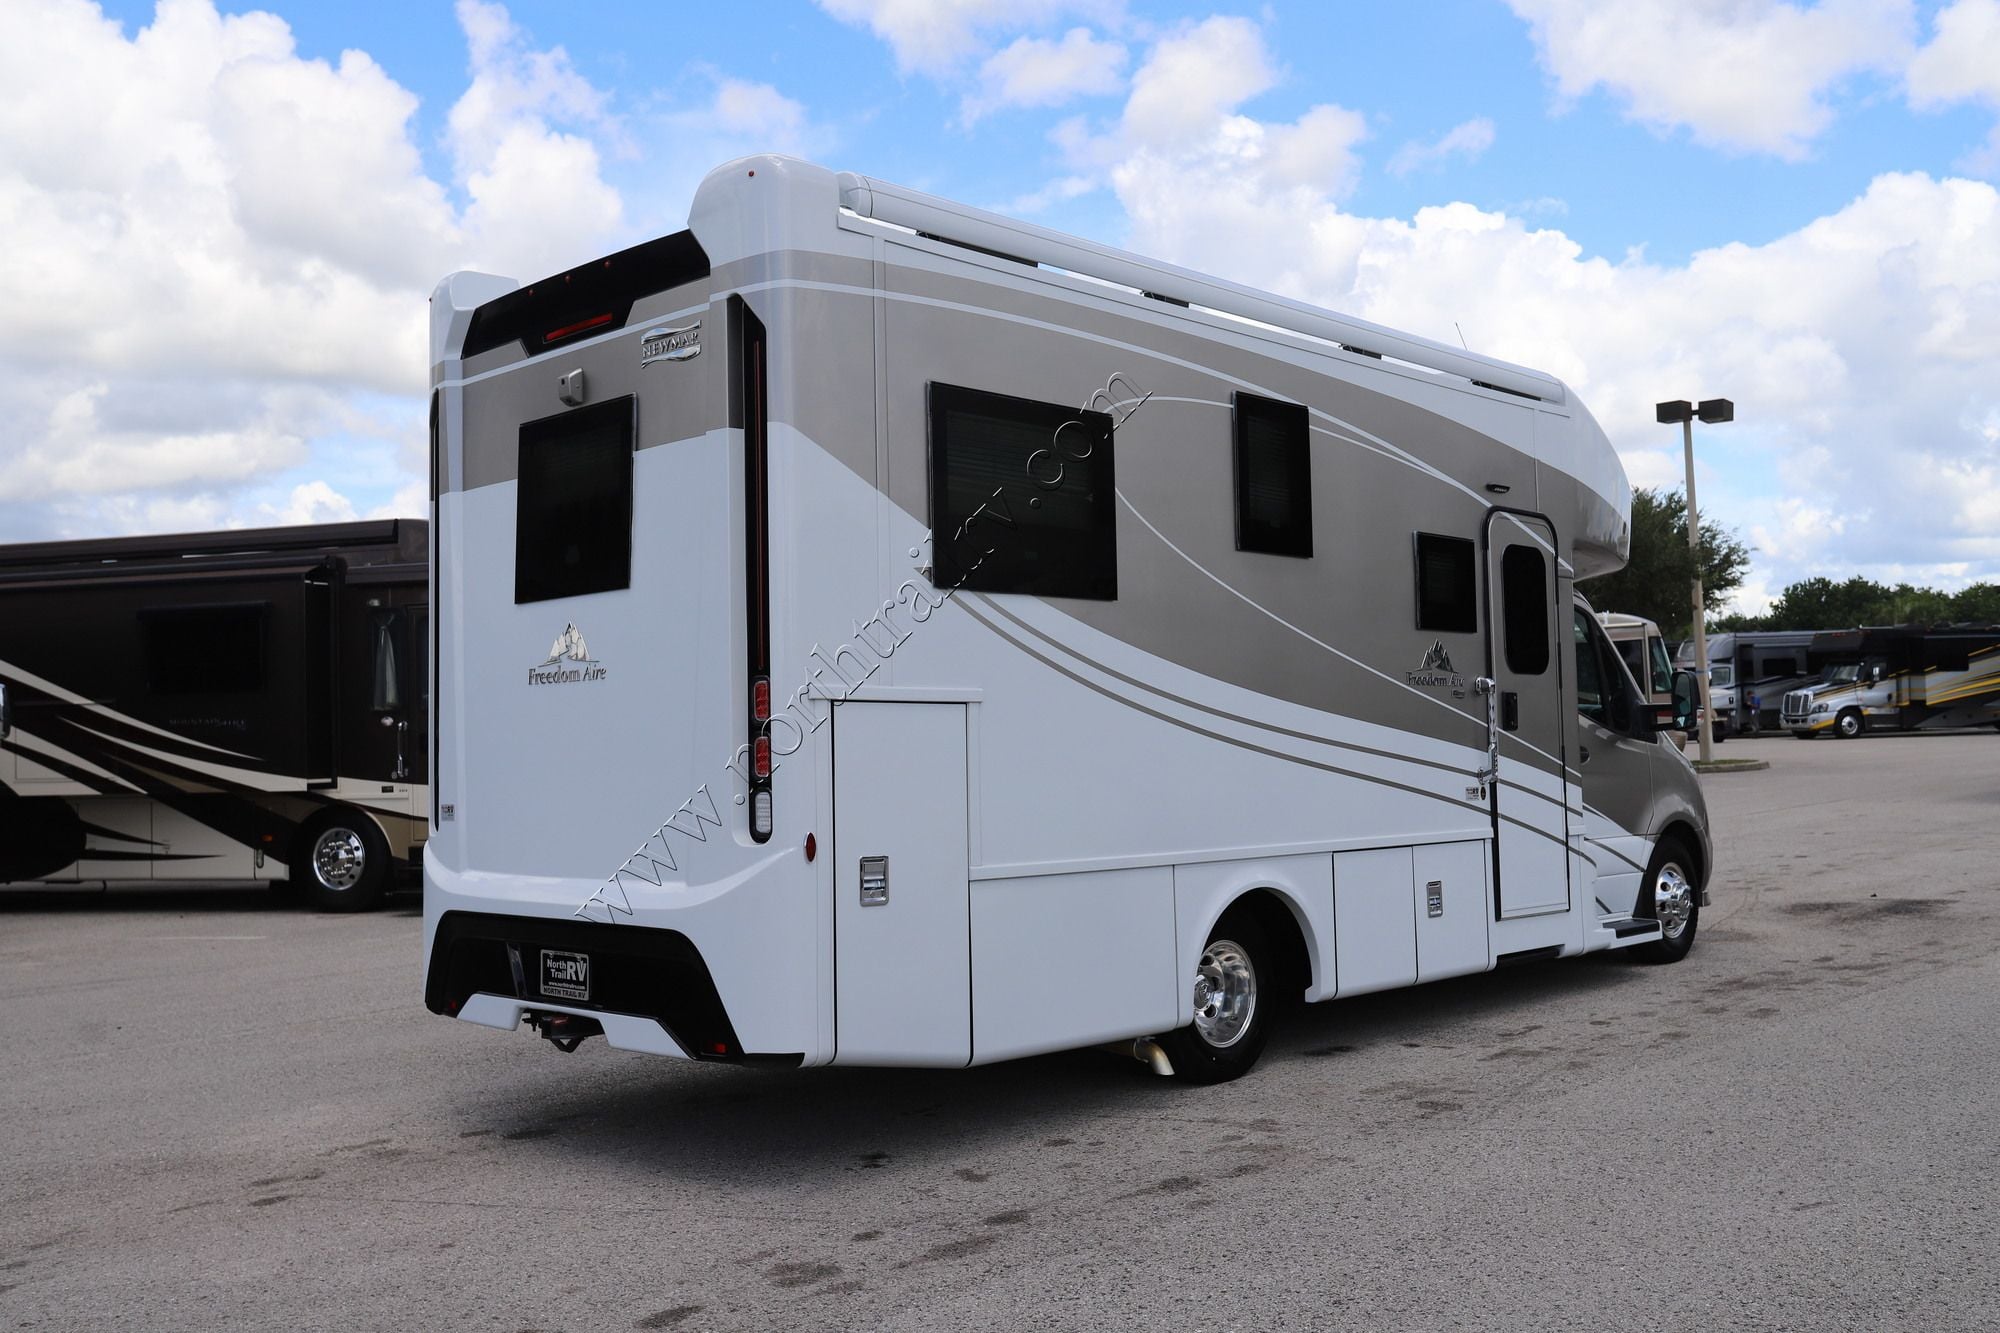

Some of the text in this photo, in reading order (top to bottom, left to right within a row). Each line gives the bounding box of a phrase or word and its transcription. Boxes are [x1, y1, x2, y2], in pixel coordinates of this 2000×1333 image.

[641, 331, 699, 358] NEWMAR
[528, 663, 607, 686] Freedom Aire
[1406, 672, 1447, 686] Freedom
[547, 959, 567, 969] North
[551, 960, 587, 982] Trail RV
[544, 987, 586, 999] NORTH TRAIL RV
